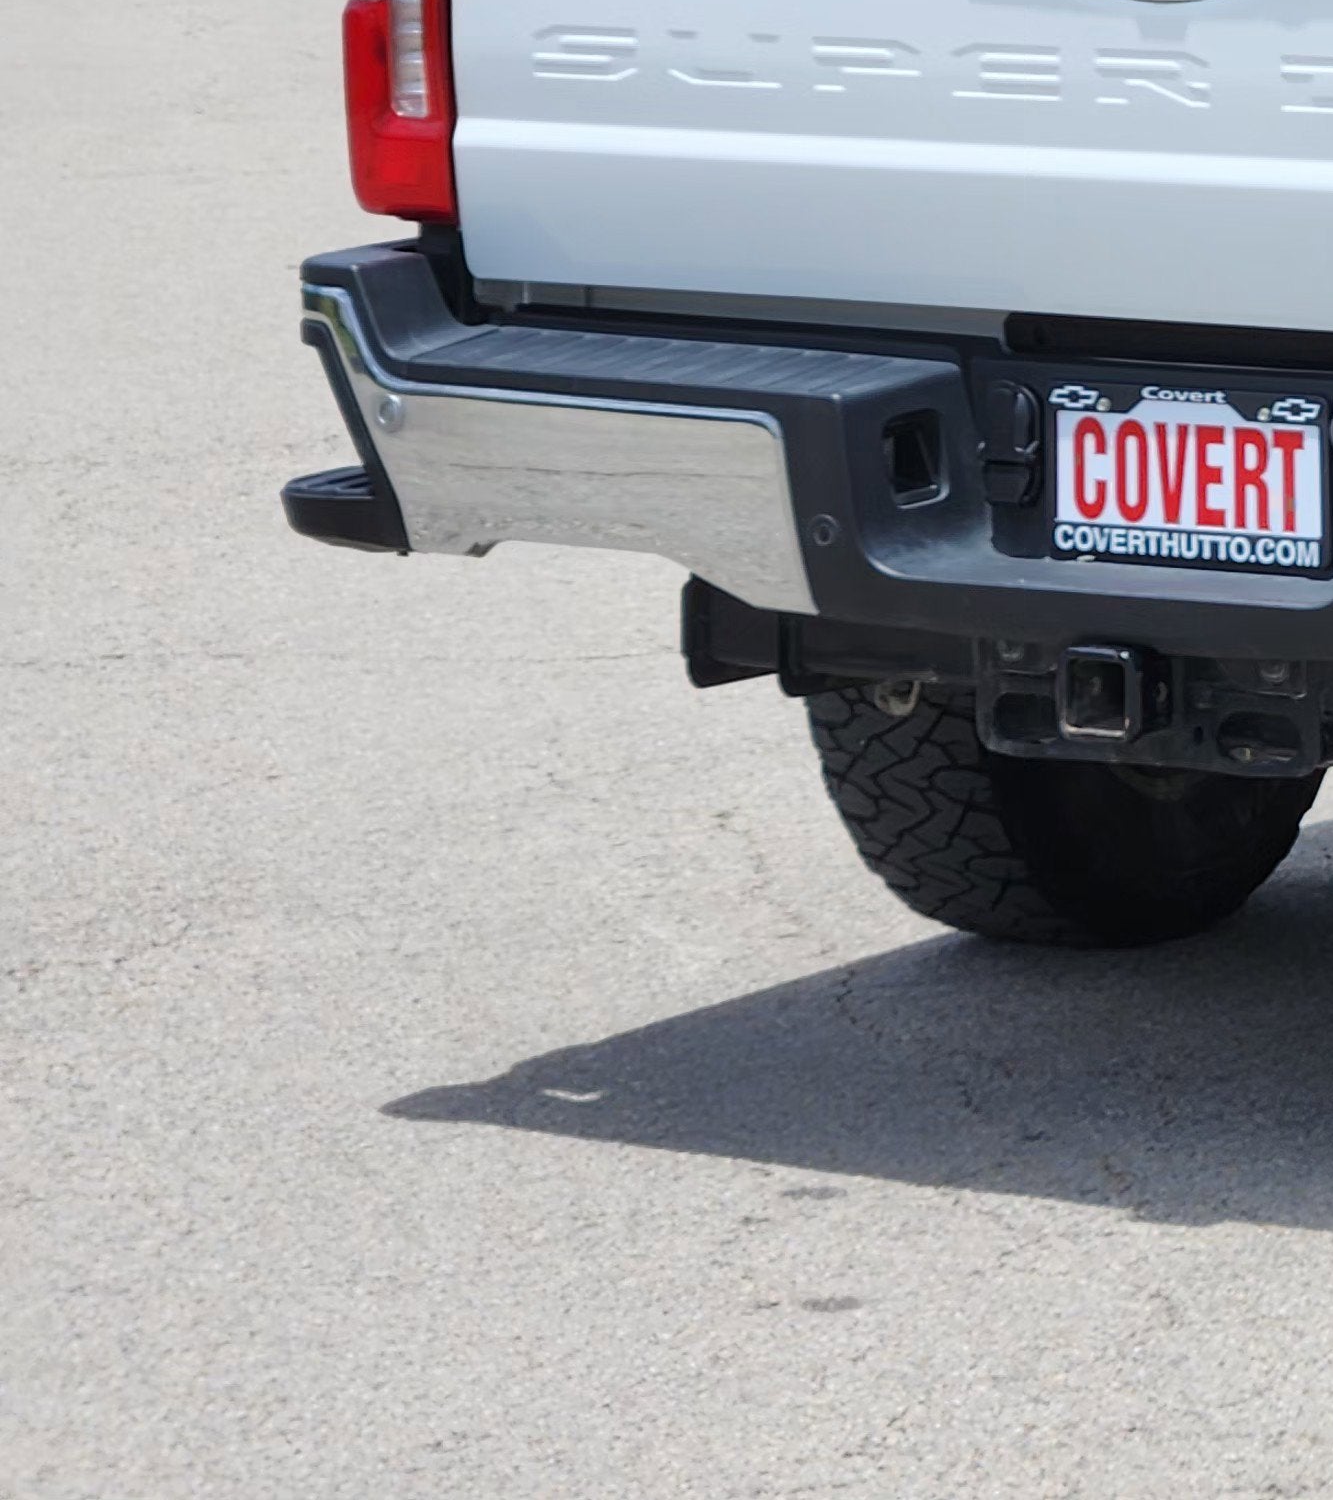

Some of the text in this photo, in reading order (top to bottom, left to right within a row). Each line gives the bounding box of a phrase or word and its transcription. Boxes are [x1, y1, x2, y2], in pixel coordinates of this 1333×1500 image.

[531, 24, 1211, 108] SUPER
[1140, 385, 1227, 404] Covert
[1073, 415, 1305, 533] COVERT
[1054, 524, 1321, 567] COVERTHUTTO.COM
